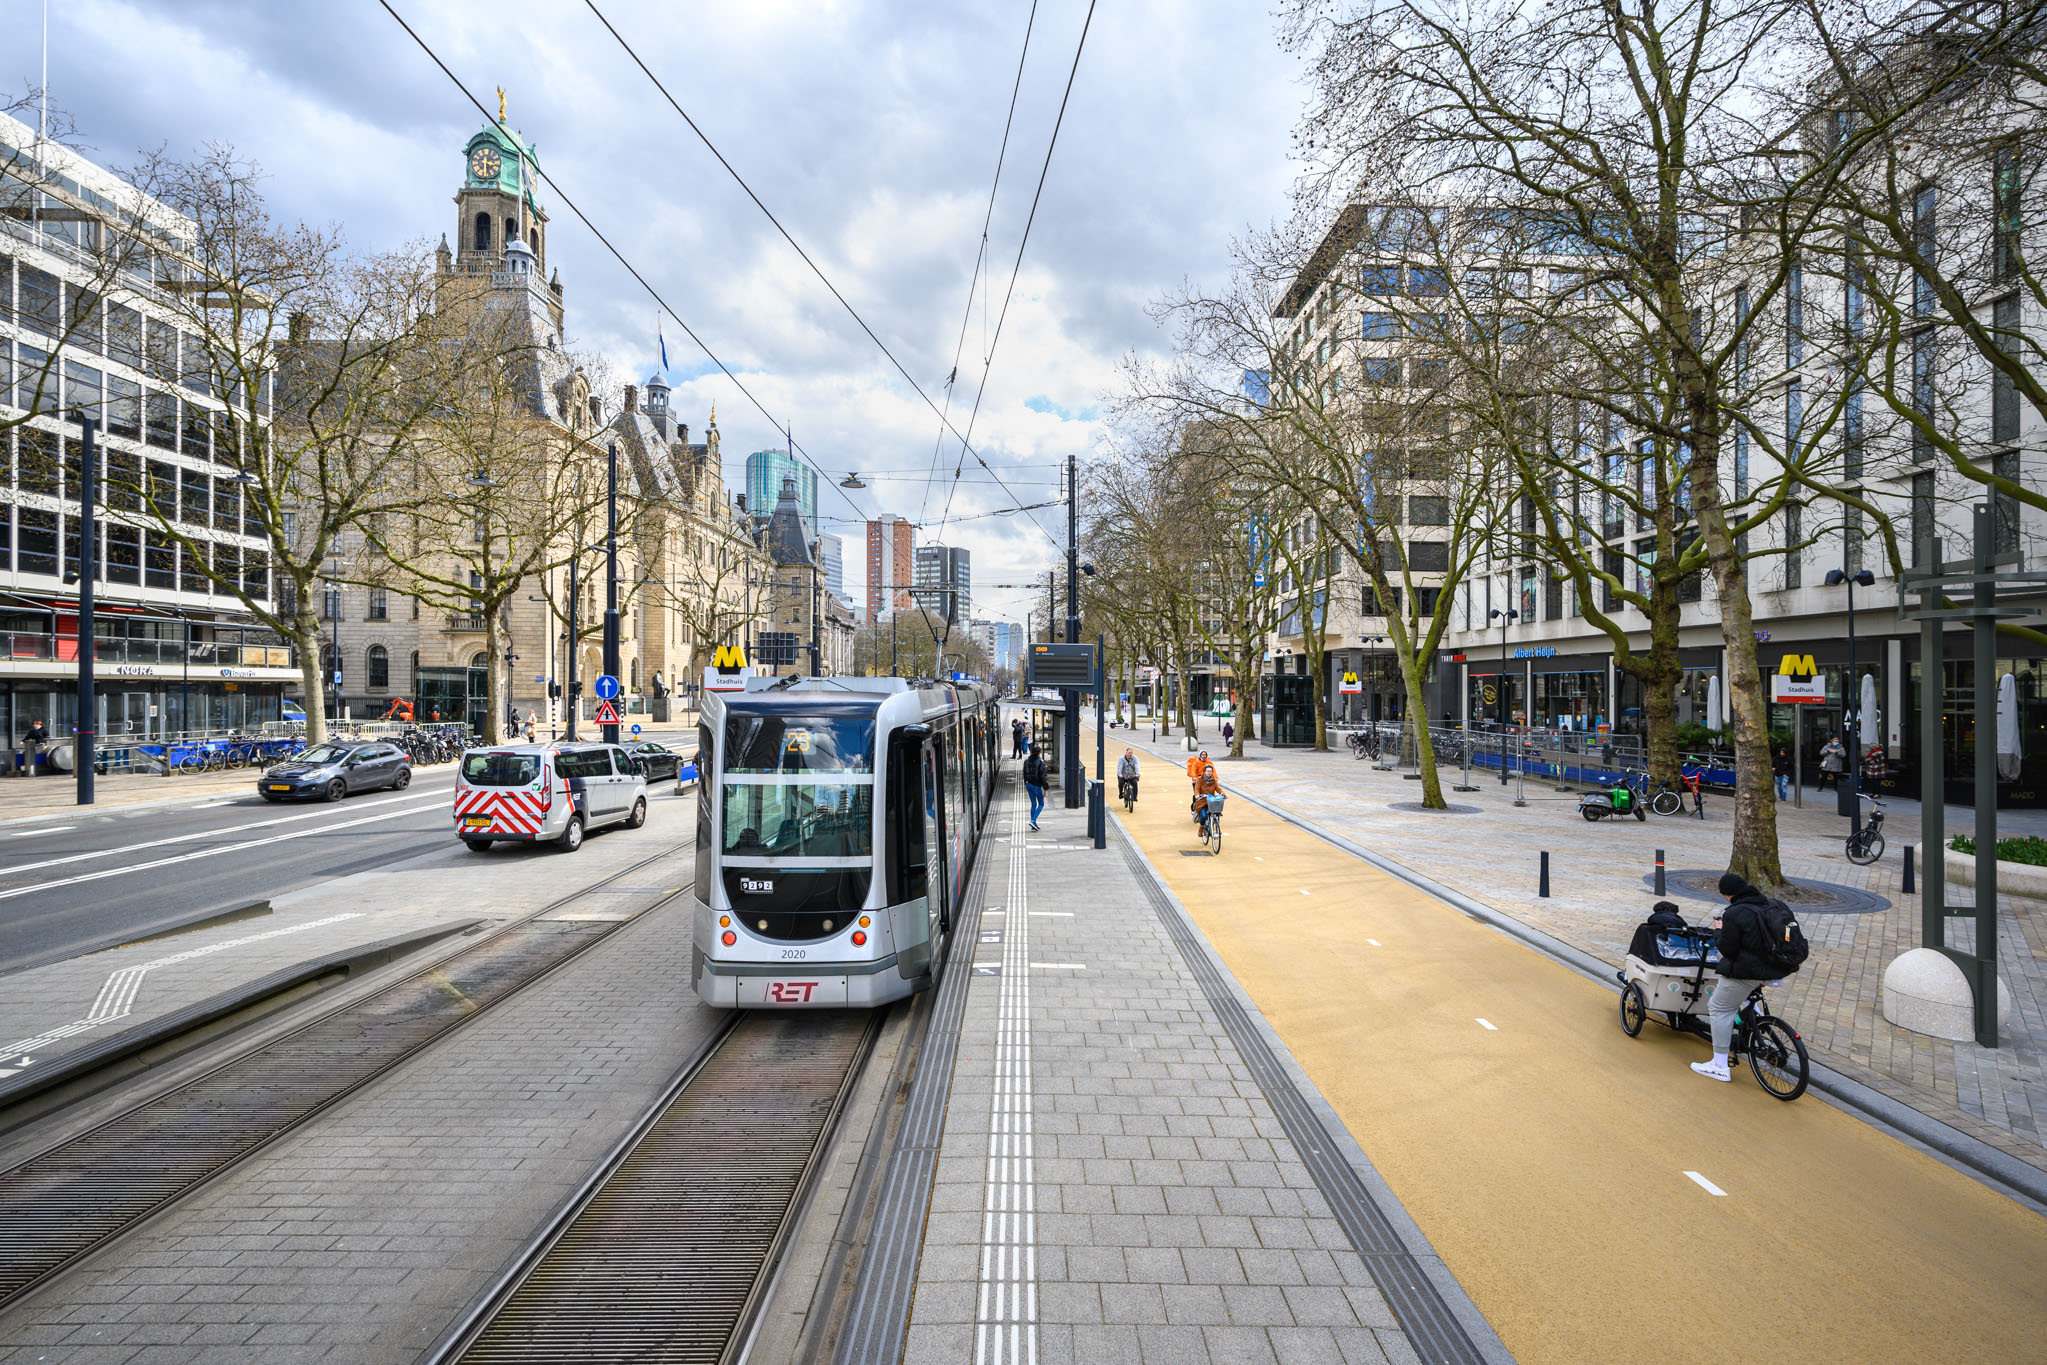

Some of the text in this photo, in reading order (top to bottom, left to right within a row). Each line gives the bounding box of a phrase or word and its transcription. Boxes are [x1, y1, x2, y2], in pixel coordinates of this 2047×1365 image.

[1513, 645, 1556, 658] Albert Heijn
[118, 666, 154, 675] NORA
[787, 732, 810, 751] 23
[2010, 791, 2036, 800] MADO
[742, 882, 772, 890] 9292
[781, 949, 806, 959] 2020
[771, 982, 819, 1002] RET
